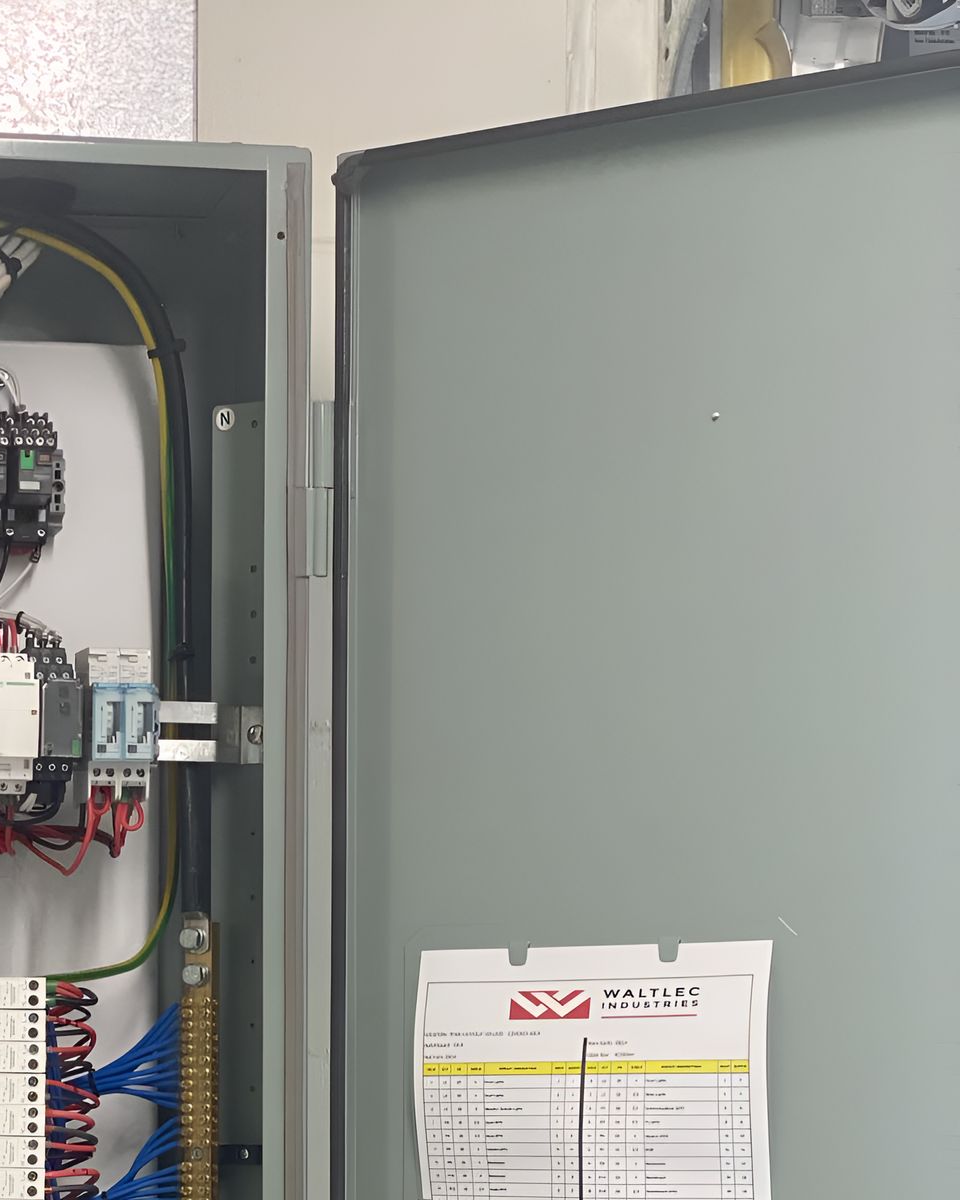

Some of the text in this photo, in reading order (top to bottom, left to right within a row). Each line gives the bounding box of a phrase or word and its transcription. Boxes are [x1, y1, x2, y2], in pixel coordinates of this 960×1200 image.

[220, 411, 230, 426] N
[603, 987, 700, 998] WALTLEC
[601, 999, 699, 1009] INDUSTRIES
